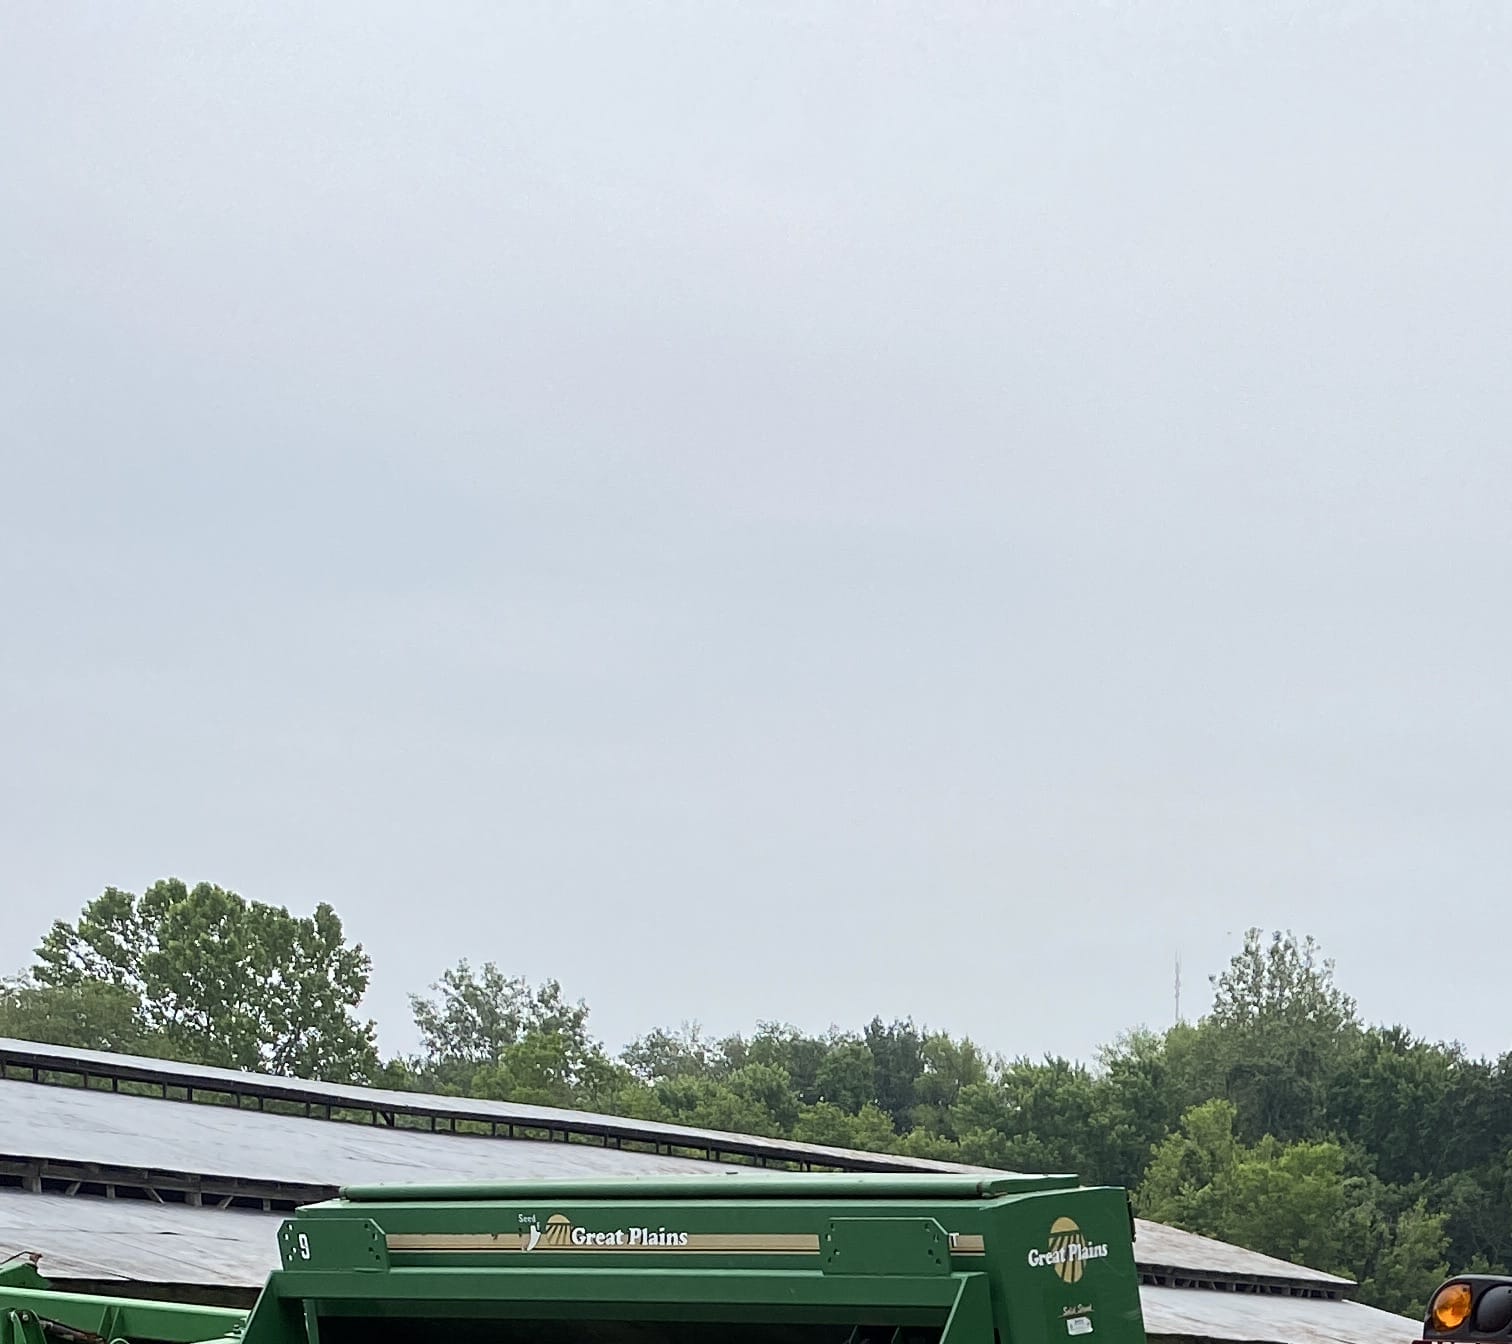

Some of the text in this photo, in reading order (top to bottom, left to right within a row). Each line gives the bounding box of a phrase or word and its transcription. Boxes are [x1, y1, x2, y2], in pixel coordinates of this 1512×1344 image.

[298, 1233, 311, 1260] 9
[571, 1227, 688, 1246] Great Plains
[1028, 1241, 1108, 1267] Great Plains
